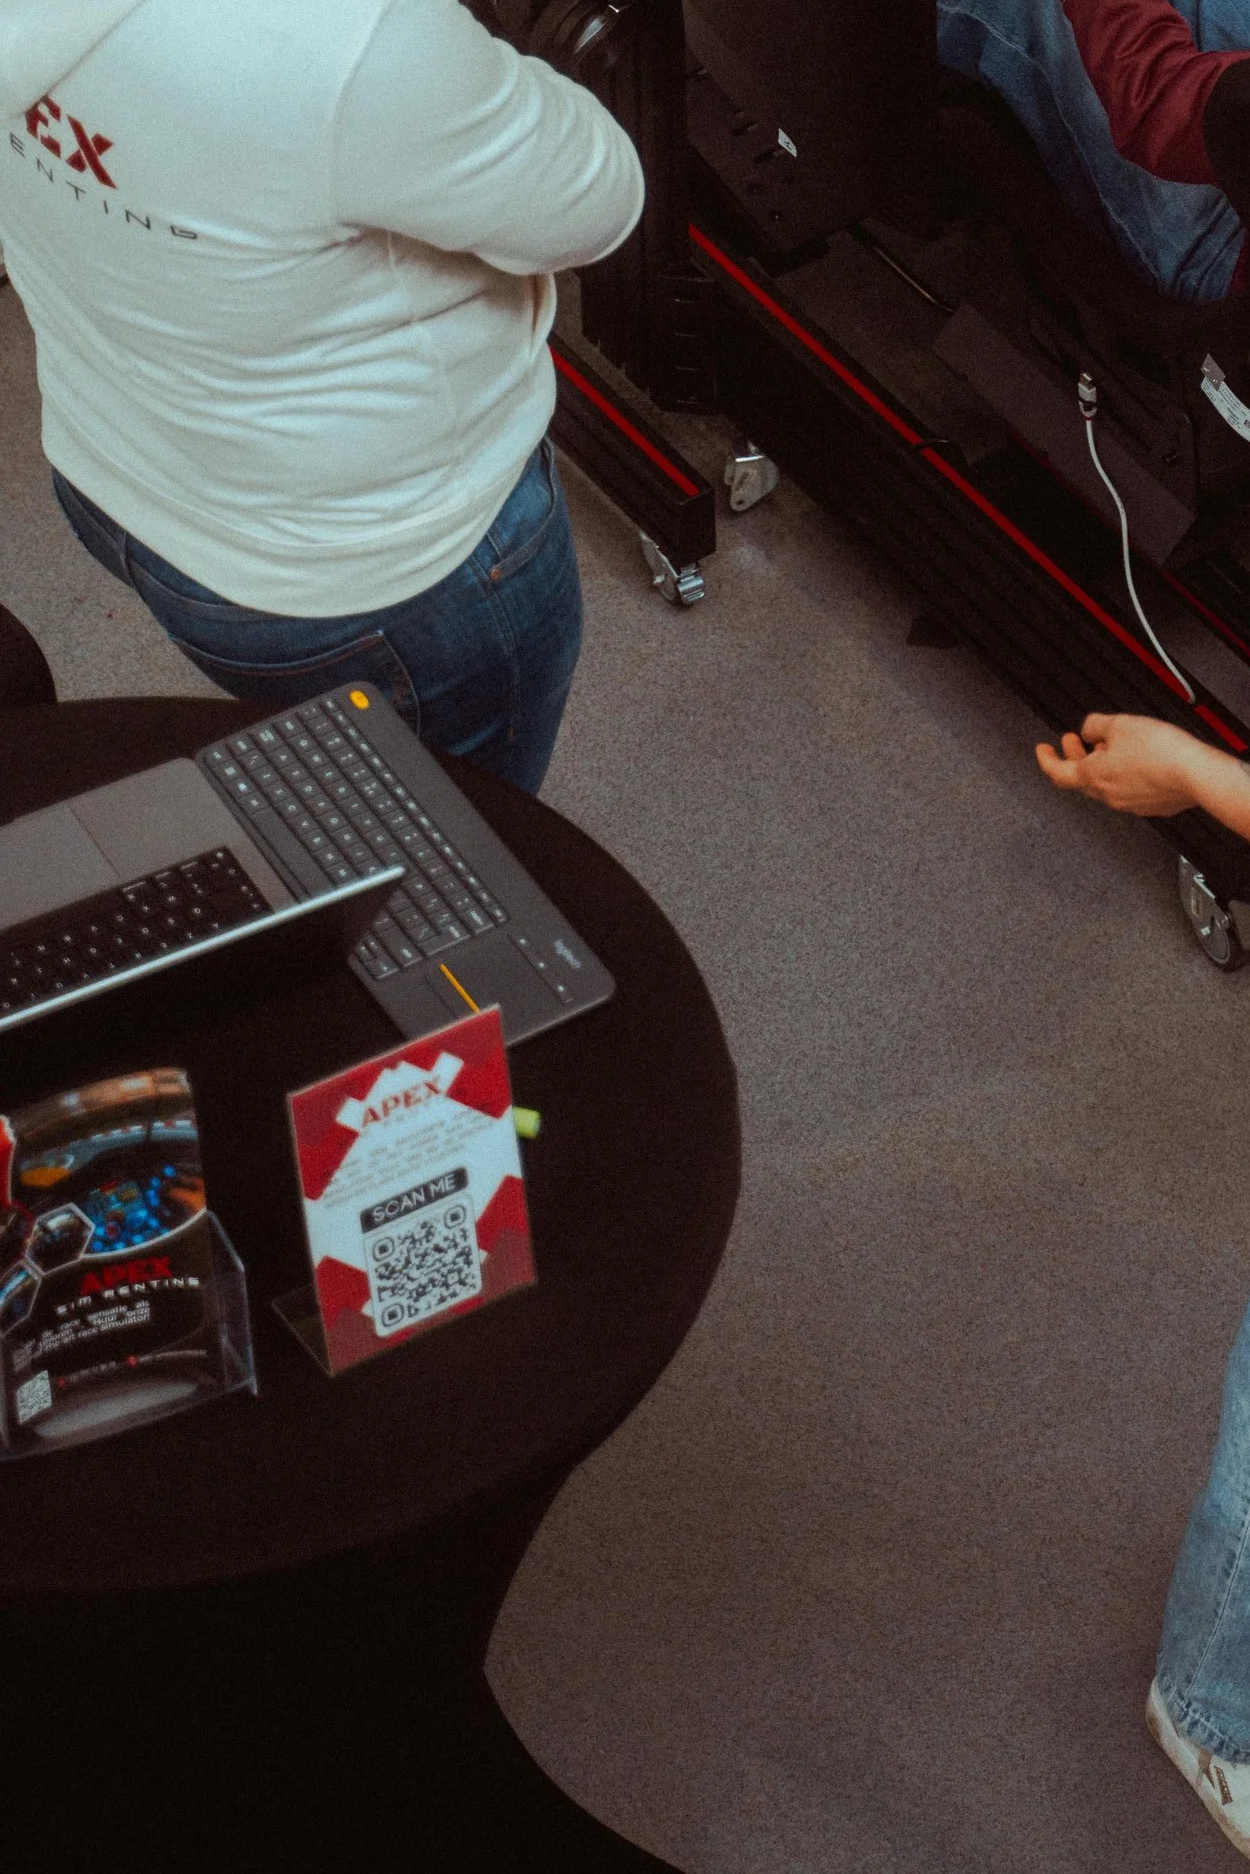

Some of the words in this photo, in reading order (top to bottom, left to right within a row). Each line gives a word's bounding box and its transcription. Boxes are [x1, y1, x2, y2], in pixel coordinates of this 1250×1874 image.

[9, 131, 199, 240] ENTING
[360, 1074, 441, 1127] APEX
[372, 1187, 426, 1223] SCAN
[430, 1176, 457, 1203] ME
[56, 1295, 92, 1314] SIM
[103, 1276, 200, 1298] RENTING
[79, 1256, 173, 1295] APEX
